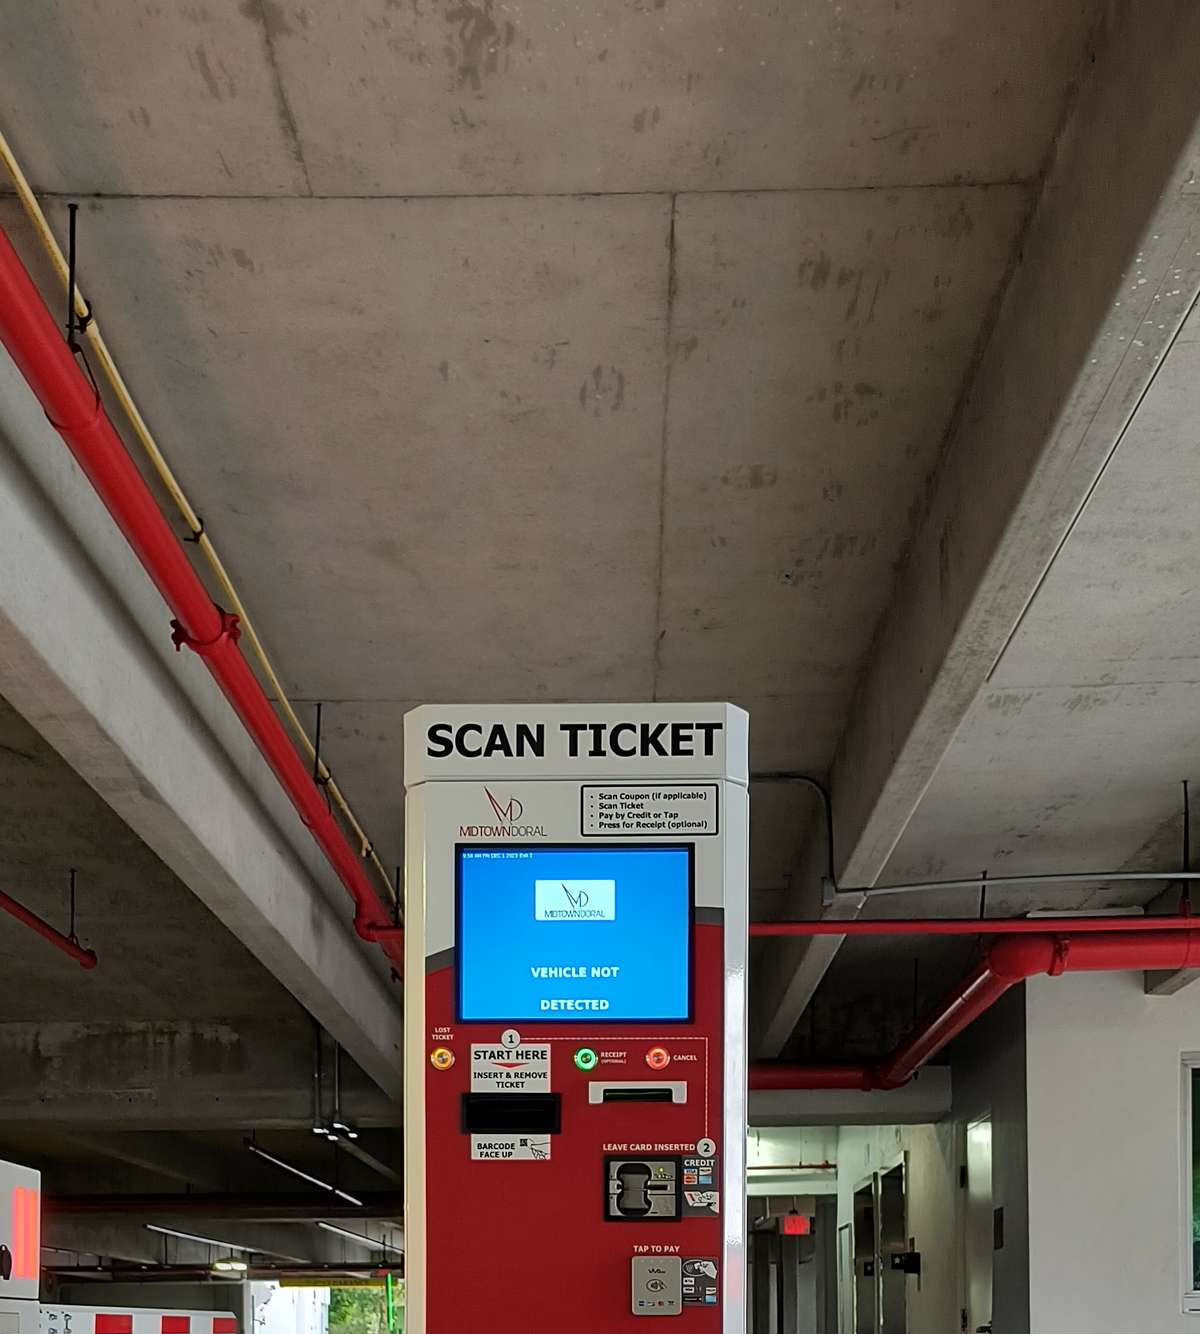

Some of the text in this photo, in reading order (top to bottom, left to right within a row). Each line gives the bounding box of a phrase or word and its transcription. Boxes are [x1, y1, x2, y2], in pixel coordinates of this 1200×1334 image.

[426, 722, 723, 758] SCAN TICKET
[619, 792, 650, 802] Coupon
[652, 792, 662, 800] (if
[663, 791, 707, 801] applicable)
[599, 802, 644, 810] Scan Ticket
[599, 812, 614, 820] Pay
[615, 811, 626, 820] by
[627, 811, 651, 819] Credit
[664, 811, 679, 820] Tap
[622, 821, 634, 829] for
[636, 821, 666, 830] Receipt
[668, 820, 708, 830] (optional)
[531, 967, 620, 978] VEHICLE NOT
[540, 999, 610, 1011] DETECTED
[508, 1034, 514, 1044] 1
[473, 1050, 548, 1060] START HERE
[496, 1081, 525, 1089] TICKET
[477, 1142, 516, 1150] BARCODE
[603, 1143, 696, 1151] LEAVE CARD INSERTED
[703, 1143, 711, 1153] 2
[684, 1159, 715, 1167] CREDIT
[633, 1245, 681, 1253] TAP TO PAY
